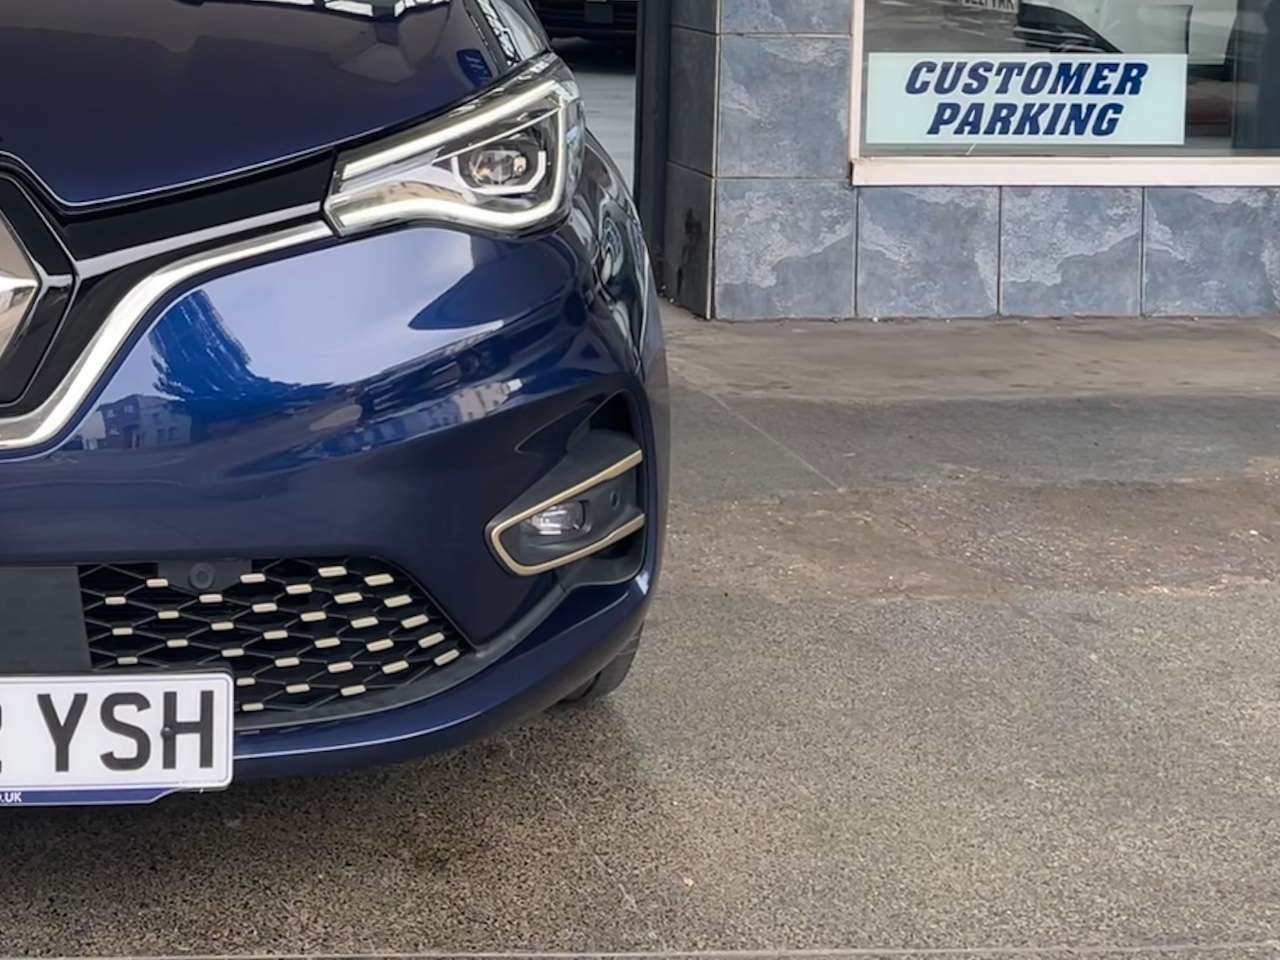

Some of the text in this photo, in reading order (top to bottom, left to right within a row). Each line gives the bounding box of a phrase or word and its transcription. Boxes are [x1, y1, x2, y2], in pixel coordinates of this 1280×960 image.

[905, 60, 1148, 96] CUSTOMER
[926, 103, 1124, 137] PARKING
[37, 690, 214, 772] YSH
